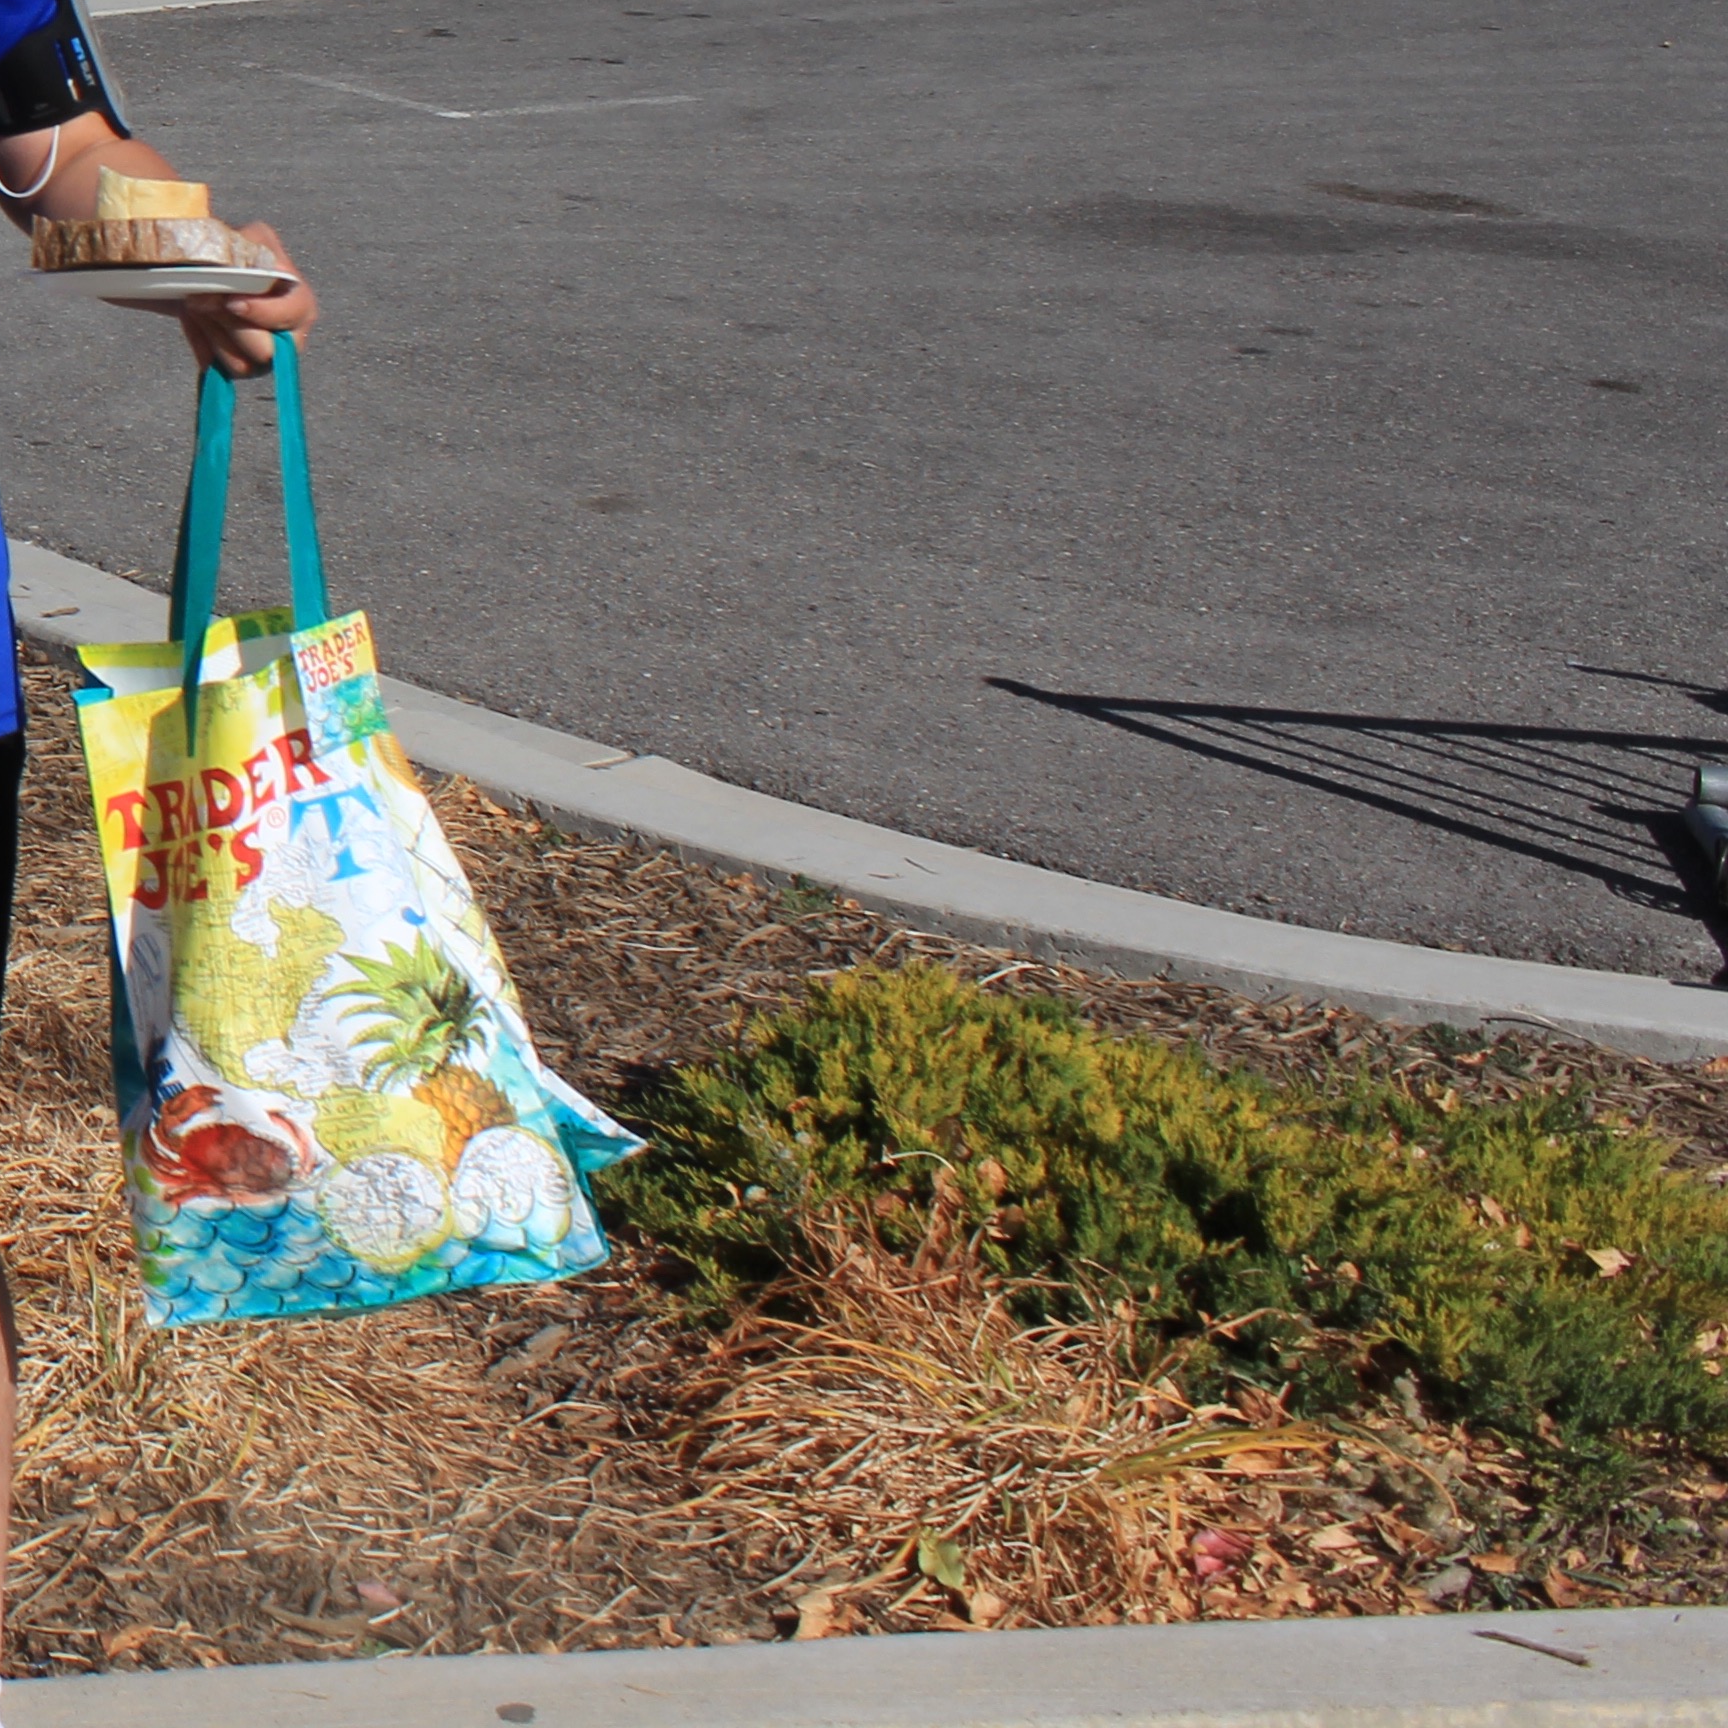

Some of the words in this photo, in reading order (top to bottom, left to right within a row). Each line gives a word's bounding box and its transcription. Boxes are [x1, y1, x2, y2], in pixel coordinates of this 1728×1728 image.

[297, 622, 367, 671] TRADER
[307, 653, 355, 693] JOE'S
[105, 728, 333, 851] TRADER
